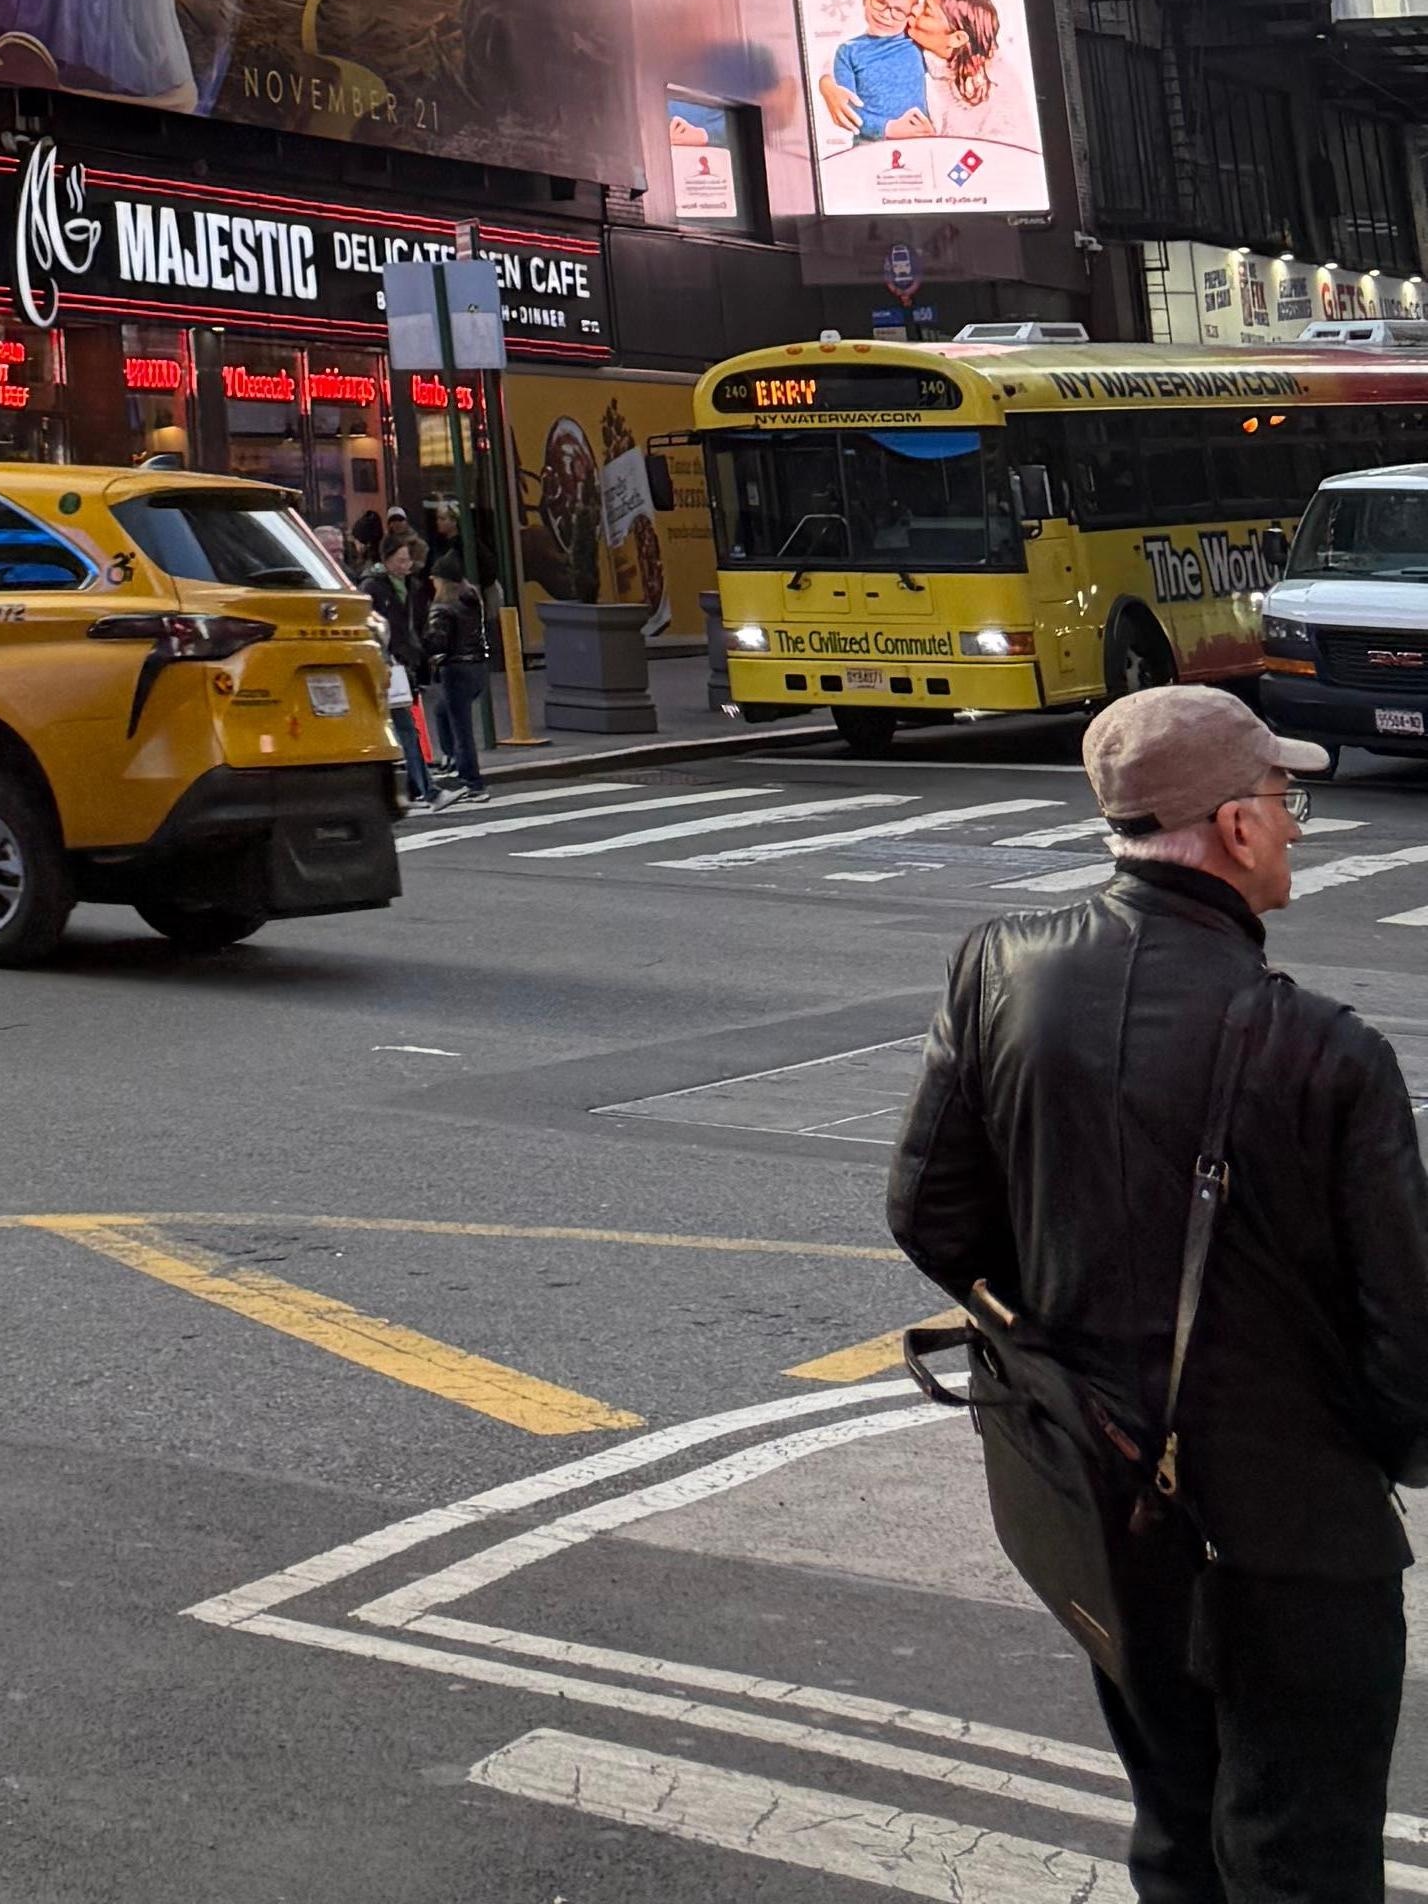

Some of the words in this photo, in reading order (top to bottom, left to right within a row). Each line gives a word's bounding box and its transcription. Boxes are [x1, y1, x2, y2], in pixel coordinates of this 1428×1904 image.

[244, 66, 398, 124] NOVEMBER
[415, 97, 439, 130] 21
[114, 200, 318, 300] MAJESTIC
[529, 256, 591, 299] CAFE
[519, 305, 567, 328] DINNER
[725, 385, 747, 399] 240
[920, 379, 945, 395] 240
[1048, 372, 1097, 400] NY
[754, 413, 777, 425] NY
[784, 412, 922, 425] WATERWAY.COM
[1143, 534, 1203, 603] The
[774, 630, 805, 654] The
[808, 630, 870, 655] Civilized
[874, 631, 953, 656] Commute!
